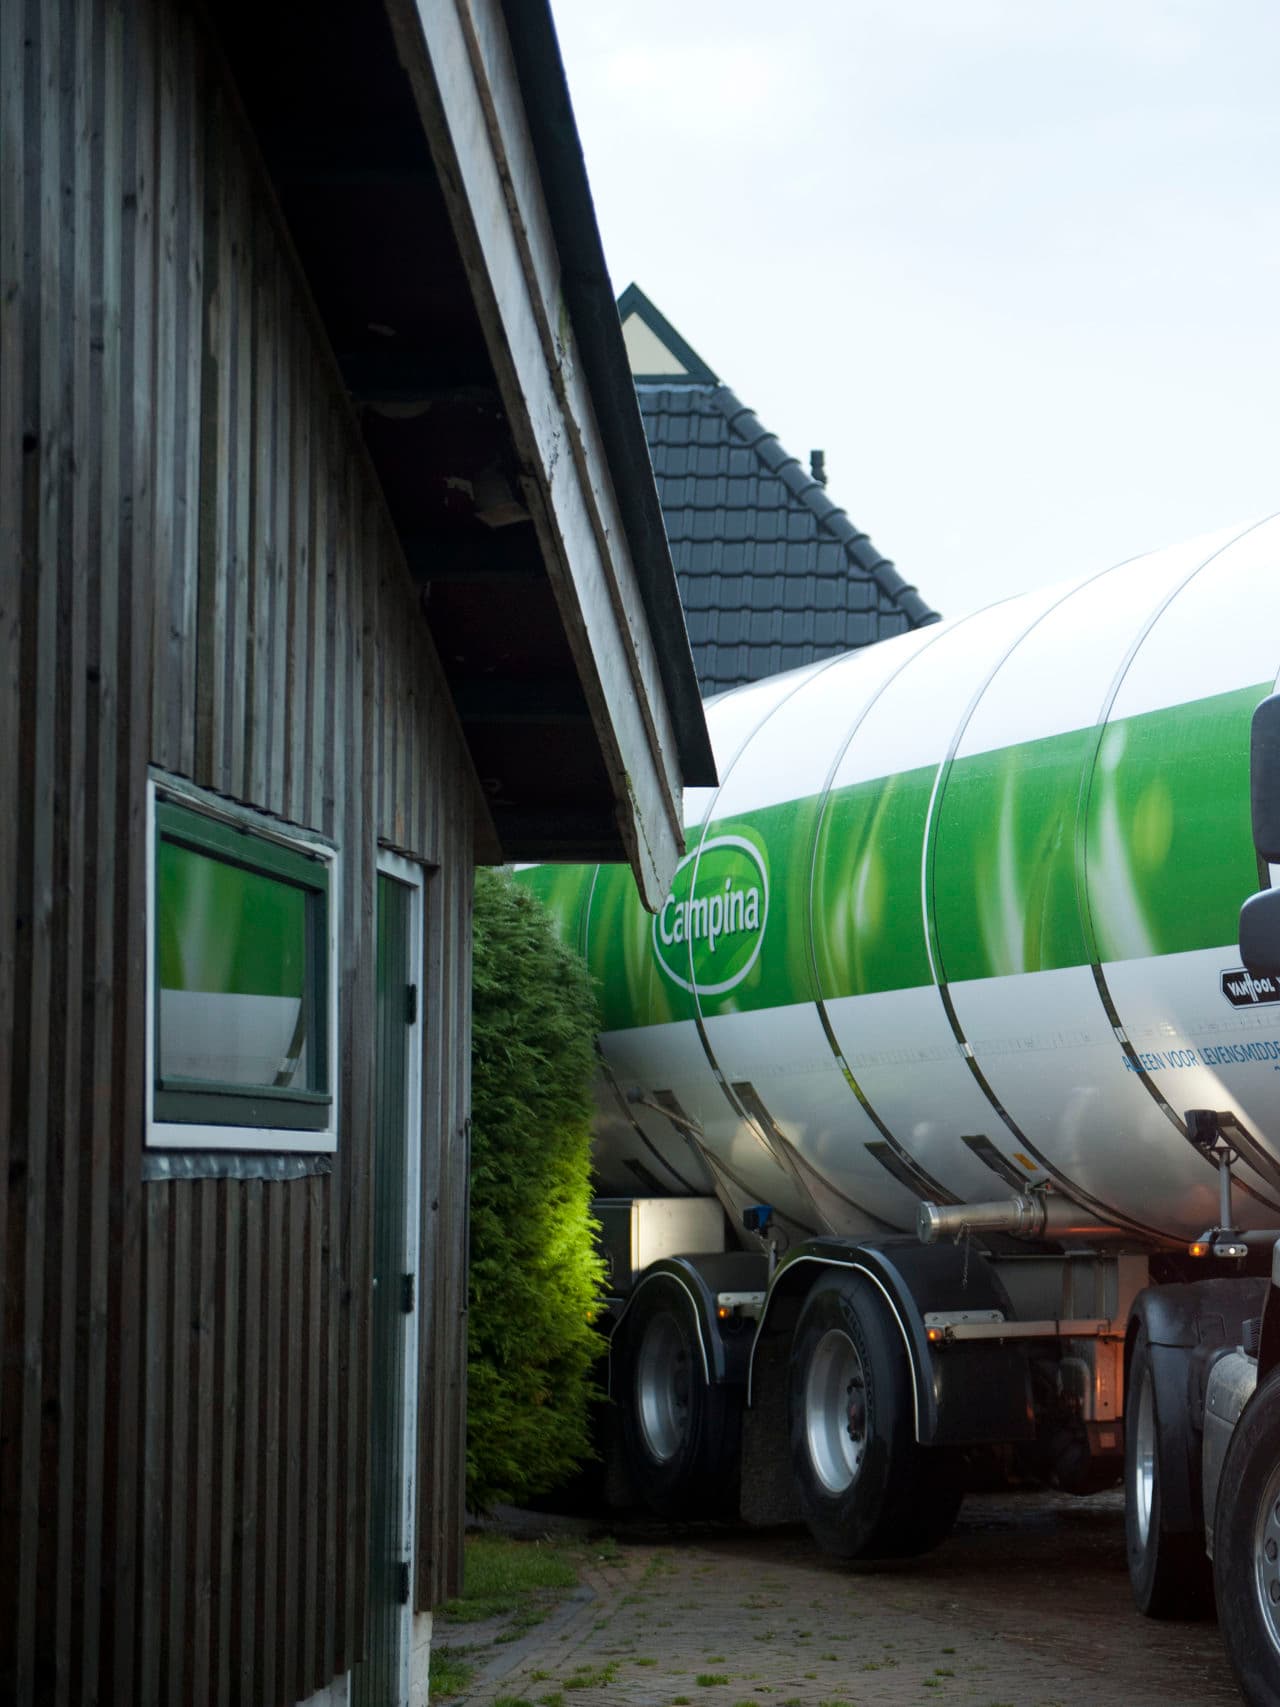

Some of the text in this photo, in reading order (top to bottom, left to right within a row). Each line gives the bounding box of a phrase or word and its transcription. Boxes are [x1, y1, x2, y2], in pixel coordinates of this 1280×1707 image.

[659, 877, 760, 952] Campina
[1122, 1050, 1164, 1073] ALLEEN
[1164, 1049, 1198, 1068] VOOR
